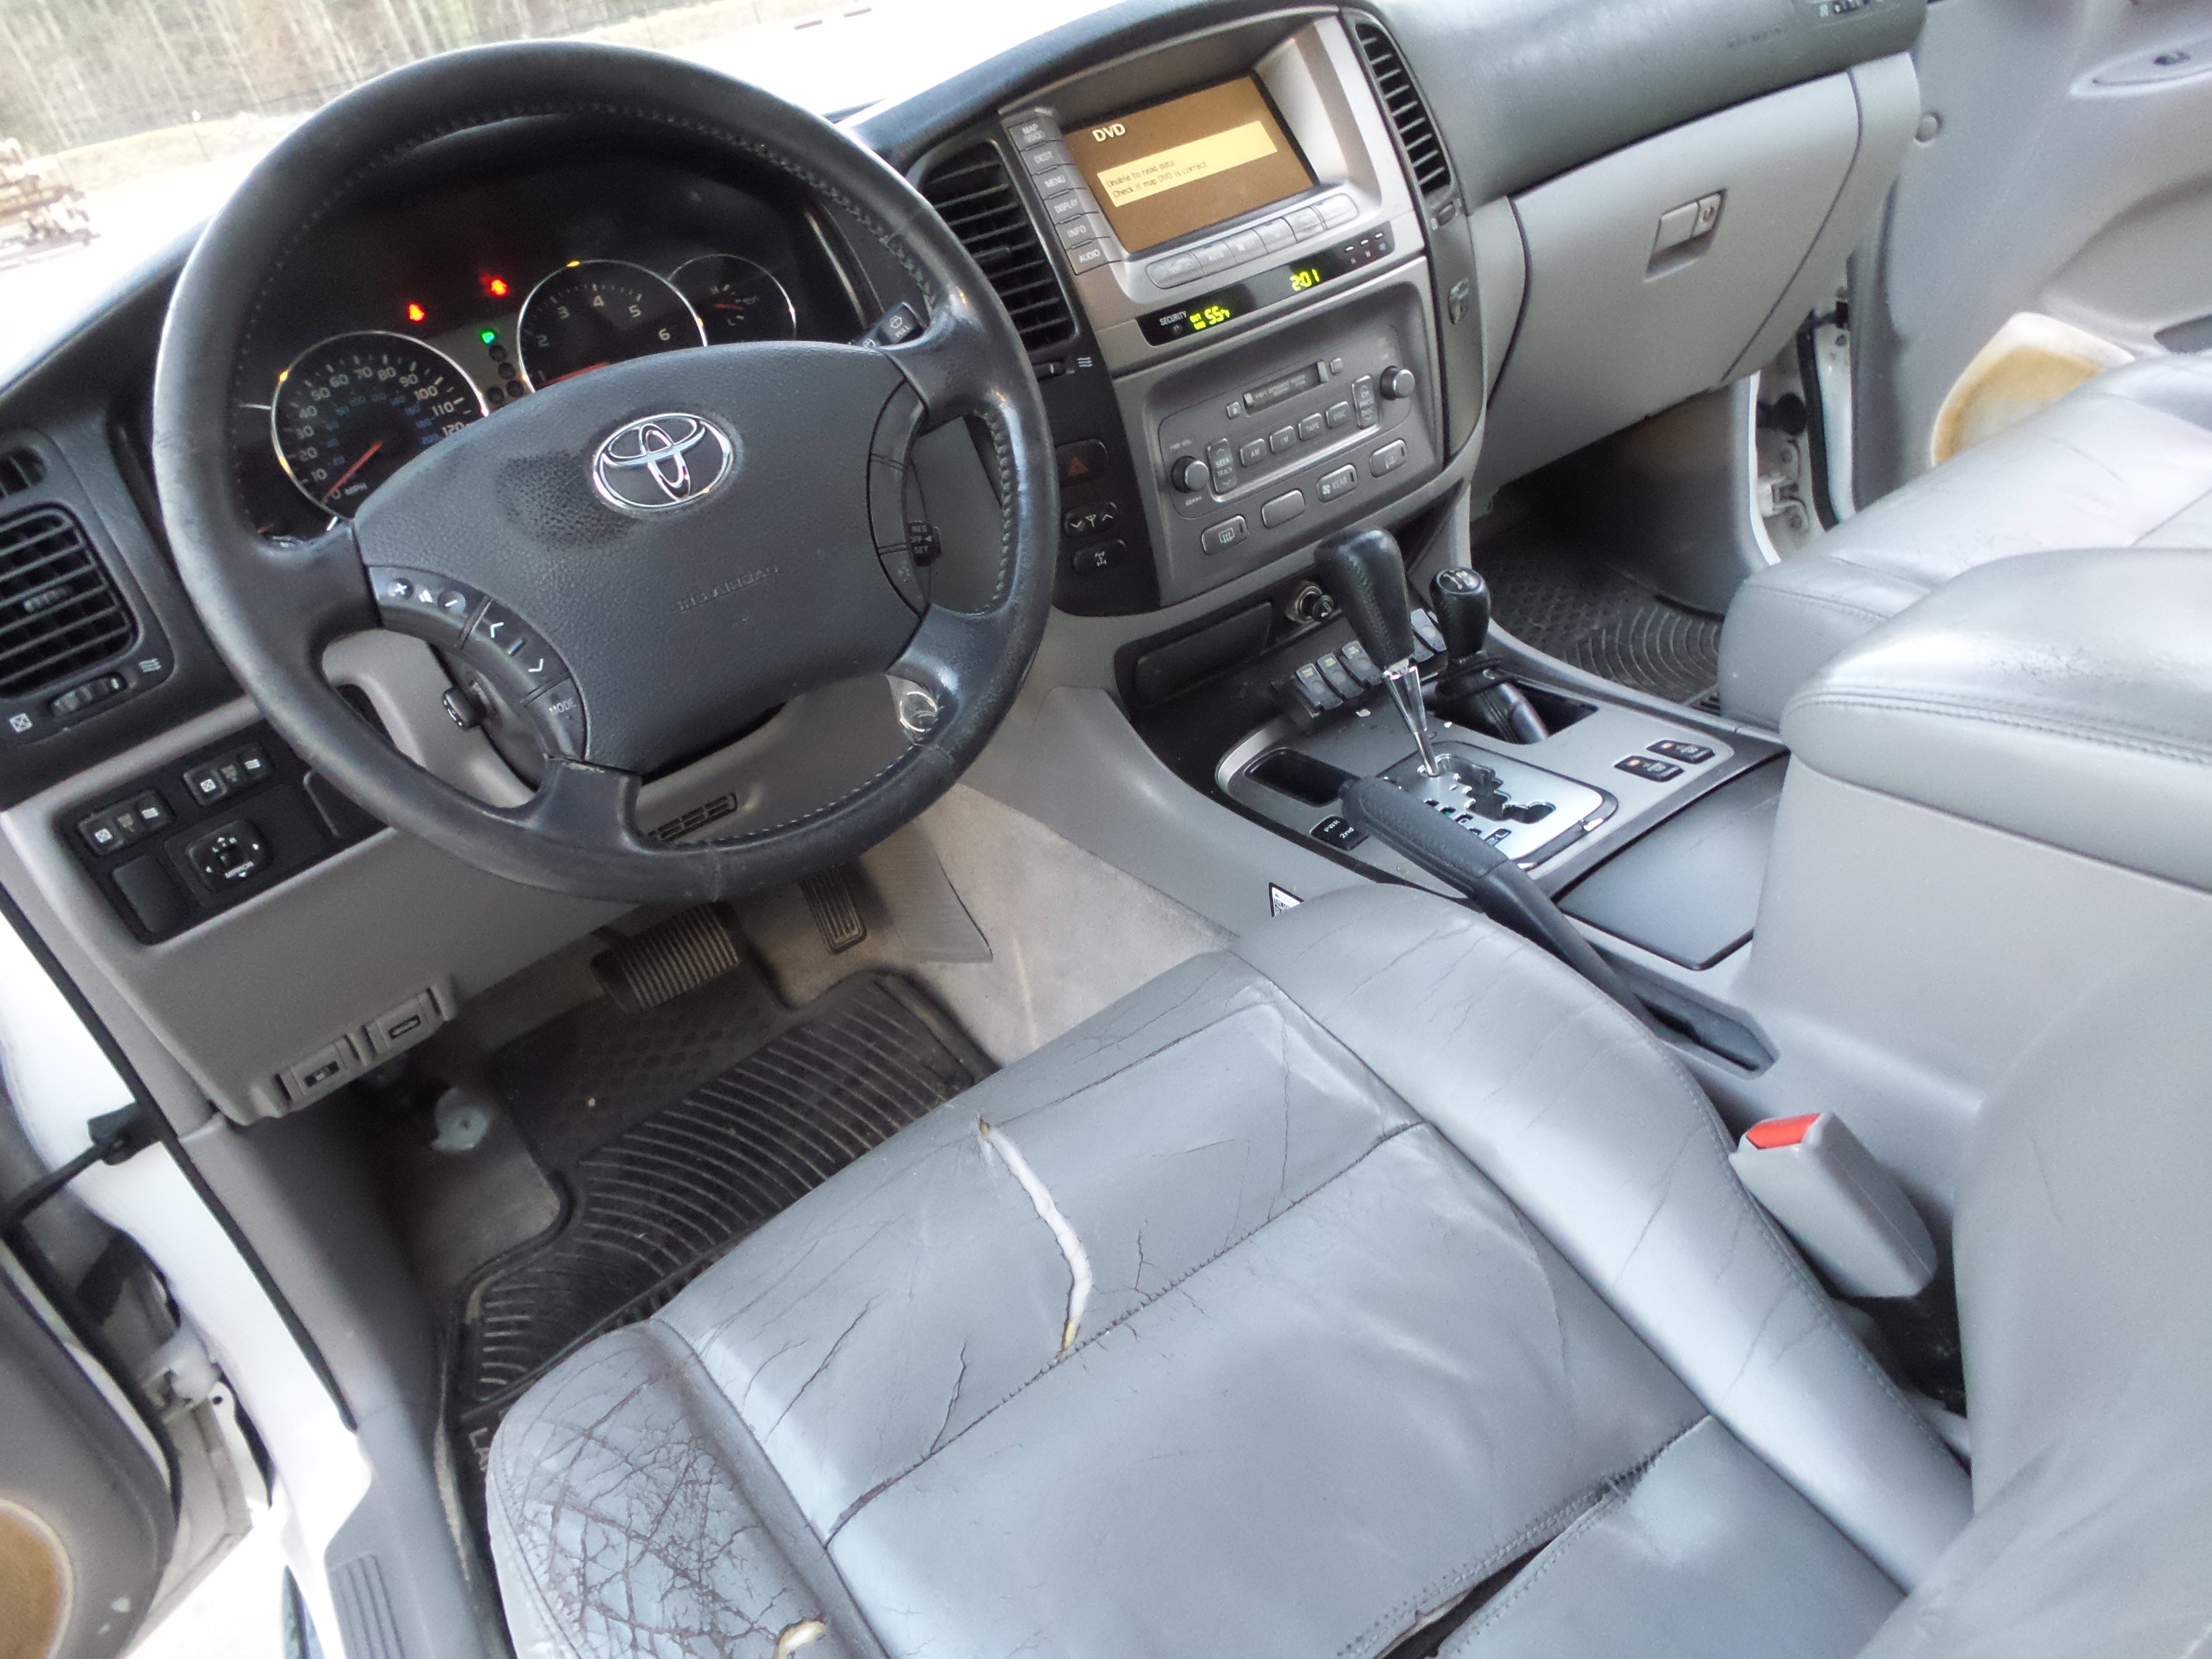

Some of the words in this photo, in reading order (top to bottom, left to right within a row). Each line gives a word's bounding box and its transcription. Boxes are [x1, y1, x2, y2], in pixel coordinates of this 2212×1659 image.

[1092, 123, 1126, 142] DVD
[1106, 175, 1130, 187] Unable
[1142, 166, 1158, 176] read
[1159, 160, 1176, 169] data
[1112, 187, 1134, 198] Check
[1157, 172, 1174, 182] DVD
[1182, 161, 1208, 175] correct
[1045, 175, 1066, 188] MENU
[1067, 225, 1086, 238] INFO
[1079, 249, 1100, 263] AUDIO
[1289, 268, 1320, 291] 2:01
[592, 295, 604, 307] 4
[557, 305, 569, 320] 3
[629, 304, 641, 317] 5
[1159, 311, 1187, 326] SECURITY
[536, 334, 550, 348] 2
[658, 328, 671, 341] 6
[330, 373, 349, 387] 60
[353, 366, 372, 380] 70
[377, 366, 397, 381] 80
[399, 373, 418, 388] 90
[311, 387, 331, 401] 50
[414, 385, 438, 400] 100
[299, 405, 317, 418] 40
[433, 401, 455, 416] 110
[296, 425, 314, 439] 30
[442, 421, 465, 437] 120
[299, 446, 318, 462] 20
[311, 468, 327, 481] 10
[549, 697, 576, 714] MODE
[1323, 820, 1340, 832] PWR
[1339, 827, 1354, 839] 2nd
